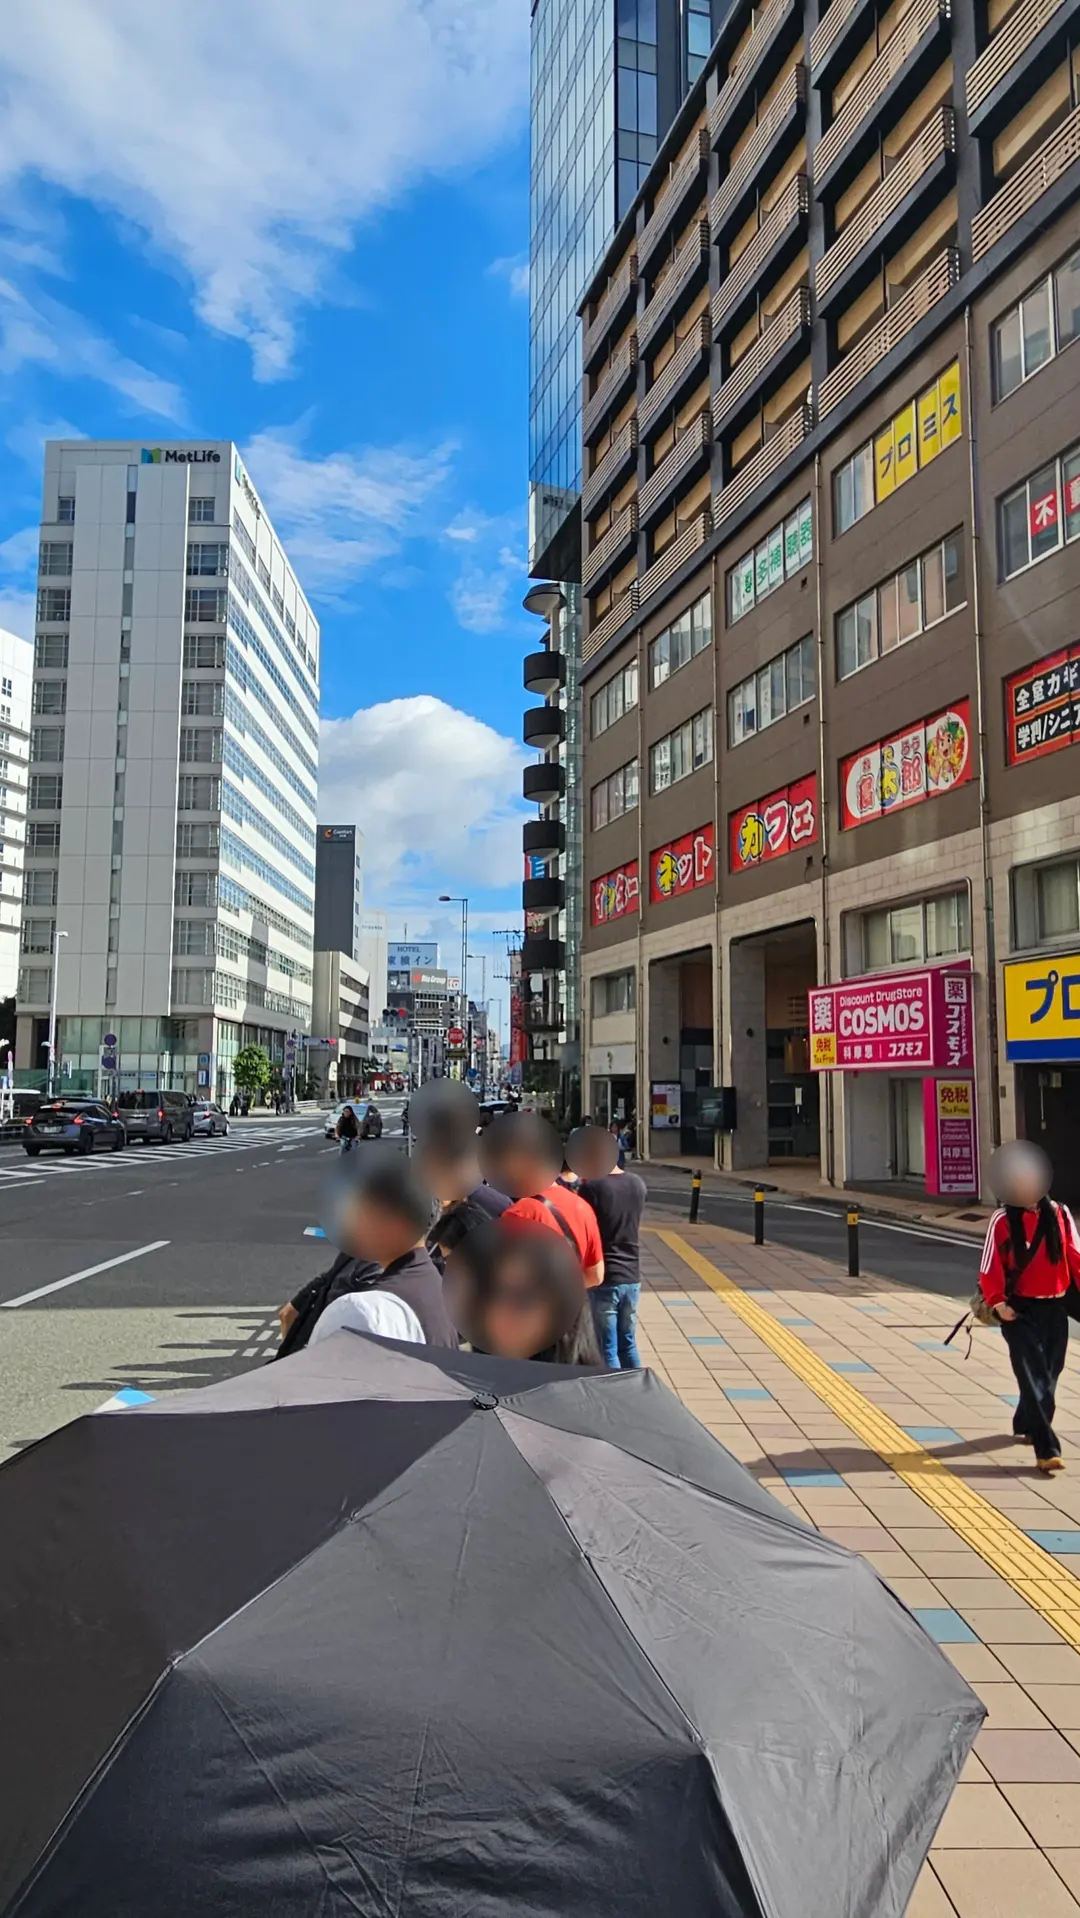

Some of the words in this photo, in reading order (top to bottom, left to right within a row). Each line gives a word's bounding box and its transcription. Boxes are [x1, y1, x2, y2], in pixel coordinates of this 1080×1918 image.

[879, 392, 958, 479] プロミス
[165, 450, 221, 463] MetLife
[1016, 663, 1078, 713] 全室カギ
[740, 800, 815, 865] カフェ
[656, 836, 711, 896] ネット
[839, 994, 875, 1008] Discount
[948, 981, 964, 999] 薬
[814, 996, 833, 1031] 薬
[839, 1001, 924, 1037] COSMOS
[816, 1037, 832, 1053] 免税
[887, 1041, 923, 1058] コスモス
[945, 1004, 961, 1067] コスモス
[940, 1086, 969, 1104] 免税
